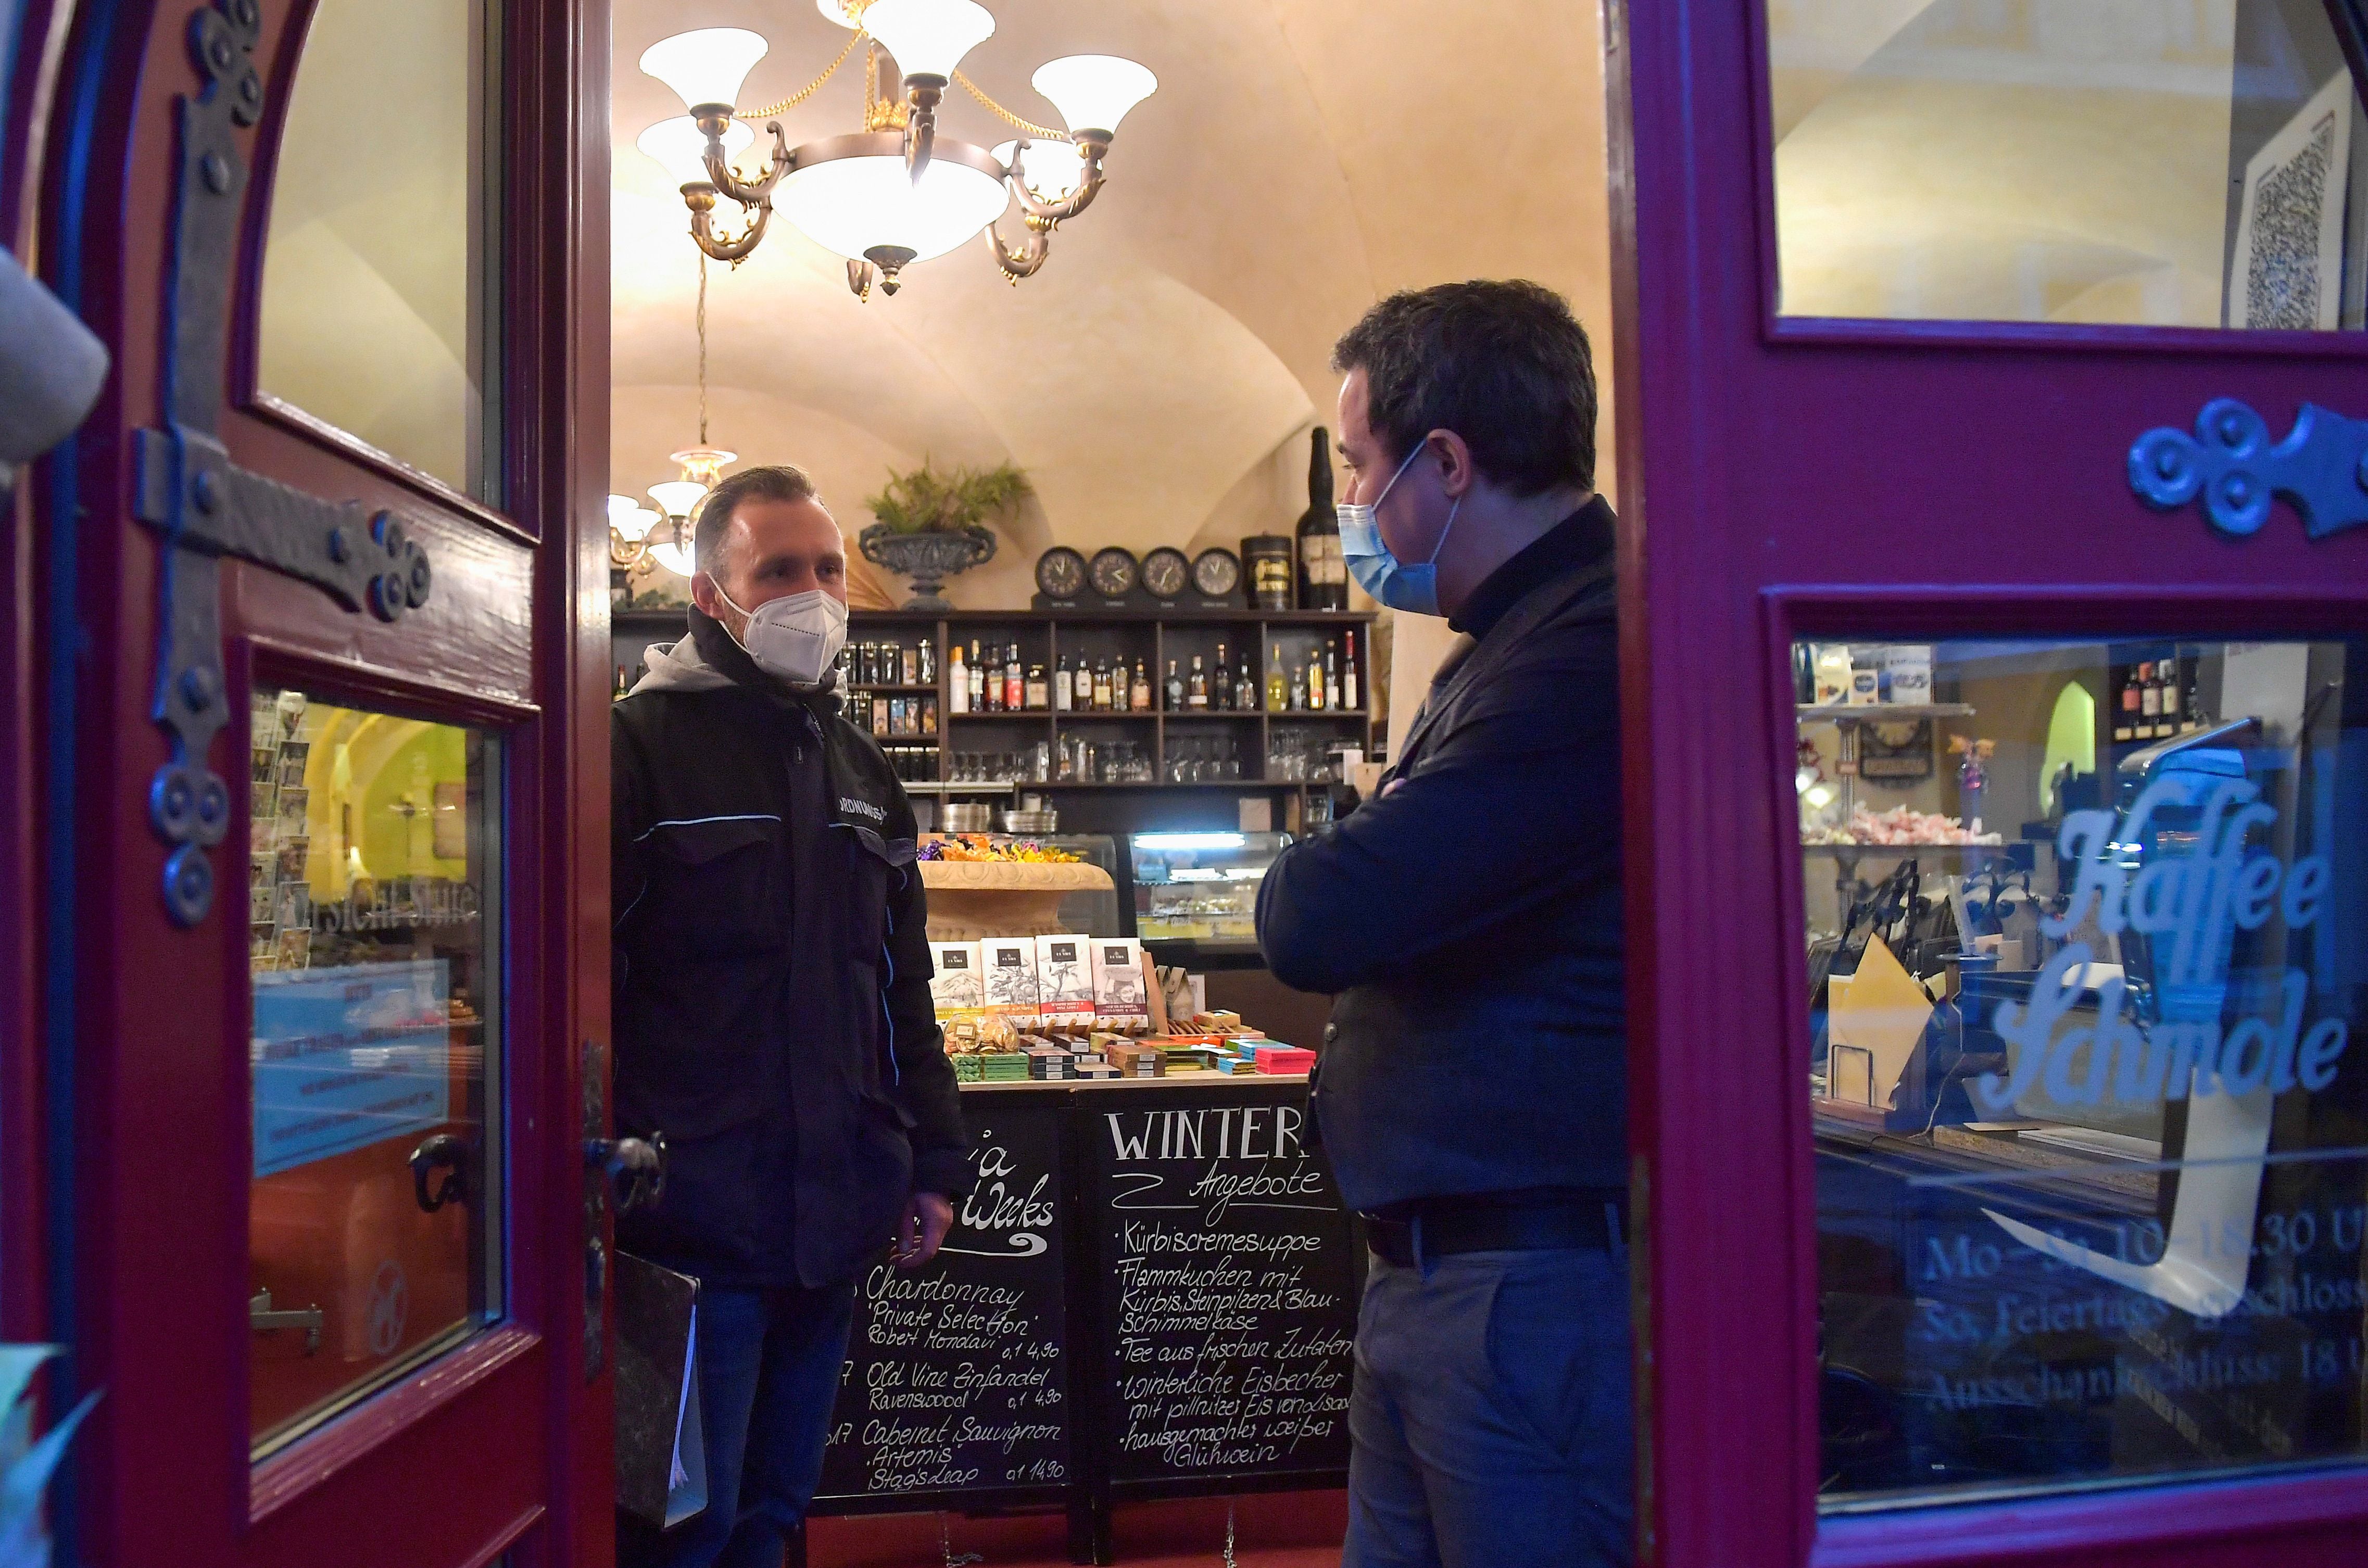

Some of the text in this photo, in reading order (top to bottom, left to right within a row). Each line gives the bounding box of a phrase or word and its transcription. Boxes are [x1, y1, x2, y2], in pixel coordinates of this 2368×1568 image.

[2039, 781, 2333, 983] Kaffee
[1980, 942, 2348, 1108] Schmole
[1103, 1106, 1310, 1160] WINTER
[961, 1173, 1054, 1230] Weeks
[1190, 1160, 1324, 1227] Angebote
[1125, 1219, 1321, 1262] Kürbiscremesuppe
[866, 1264, 1025, 1313] Chardonnay
[1118, 1255, 1303, 1288] Flammkuchen mit
[868, 1323, 1001, 1349] Robert Mondavi
[1118, 1310, 1258, 1334] Schimmelkäse
[1122, 1337, 1153, 1362] Tee
[1157, 1346, 1194, 1362] aus
[1274, 1327, 1353, 1359] Zutaten
[867, 1360, 906, 1387] Old
[912, 1362, 948, 1387] Vine
[1241, 1359, 1344, 1395] Eisbecher
[868, 1387, 969, 1411] Ravenswood
[1129, 1397, 1163, 1421] mit
[1244, 1394, 1274, 1418] Eis
[862, 1414, 952, 1445] Cabernet
[952, 1416, 1061, 1455] Sauvignon
[1174, 1441, 1281, 1467] Glühwein
